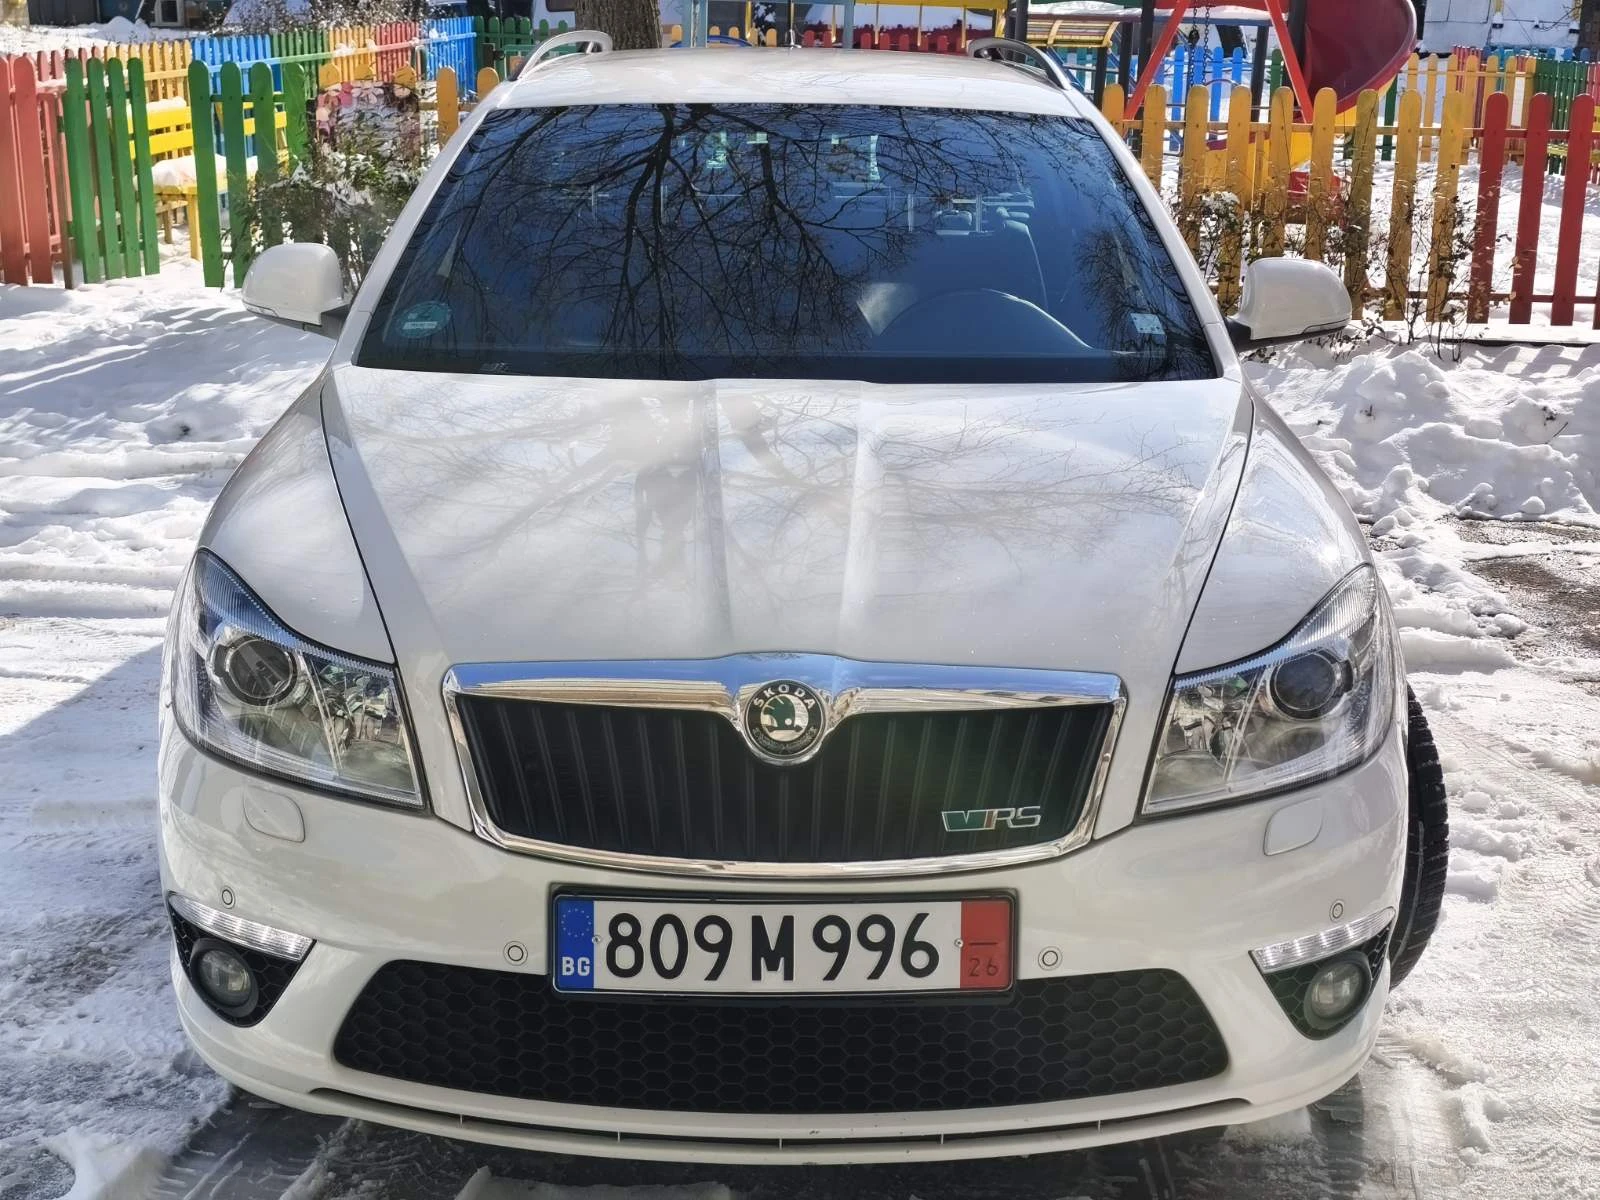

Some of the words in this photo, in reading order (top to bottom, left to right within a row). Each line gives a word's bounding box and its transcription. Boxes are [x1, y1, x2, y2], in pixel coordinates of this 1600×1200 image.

[606, 912, 733, 981] 809
[751, 914, 795, 981] M
[812, 913, 940, 981] 996
[561, 956, 590, 976] BG
[968, 957, 999, 977] 26
